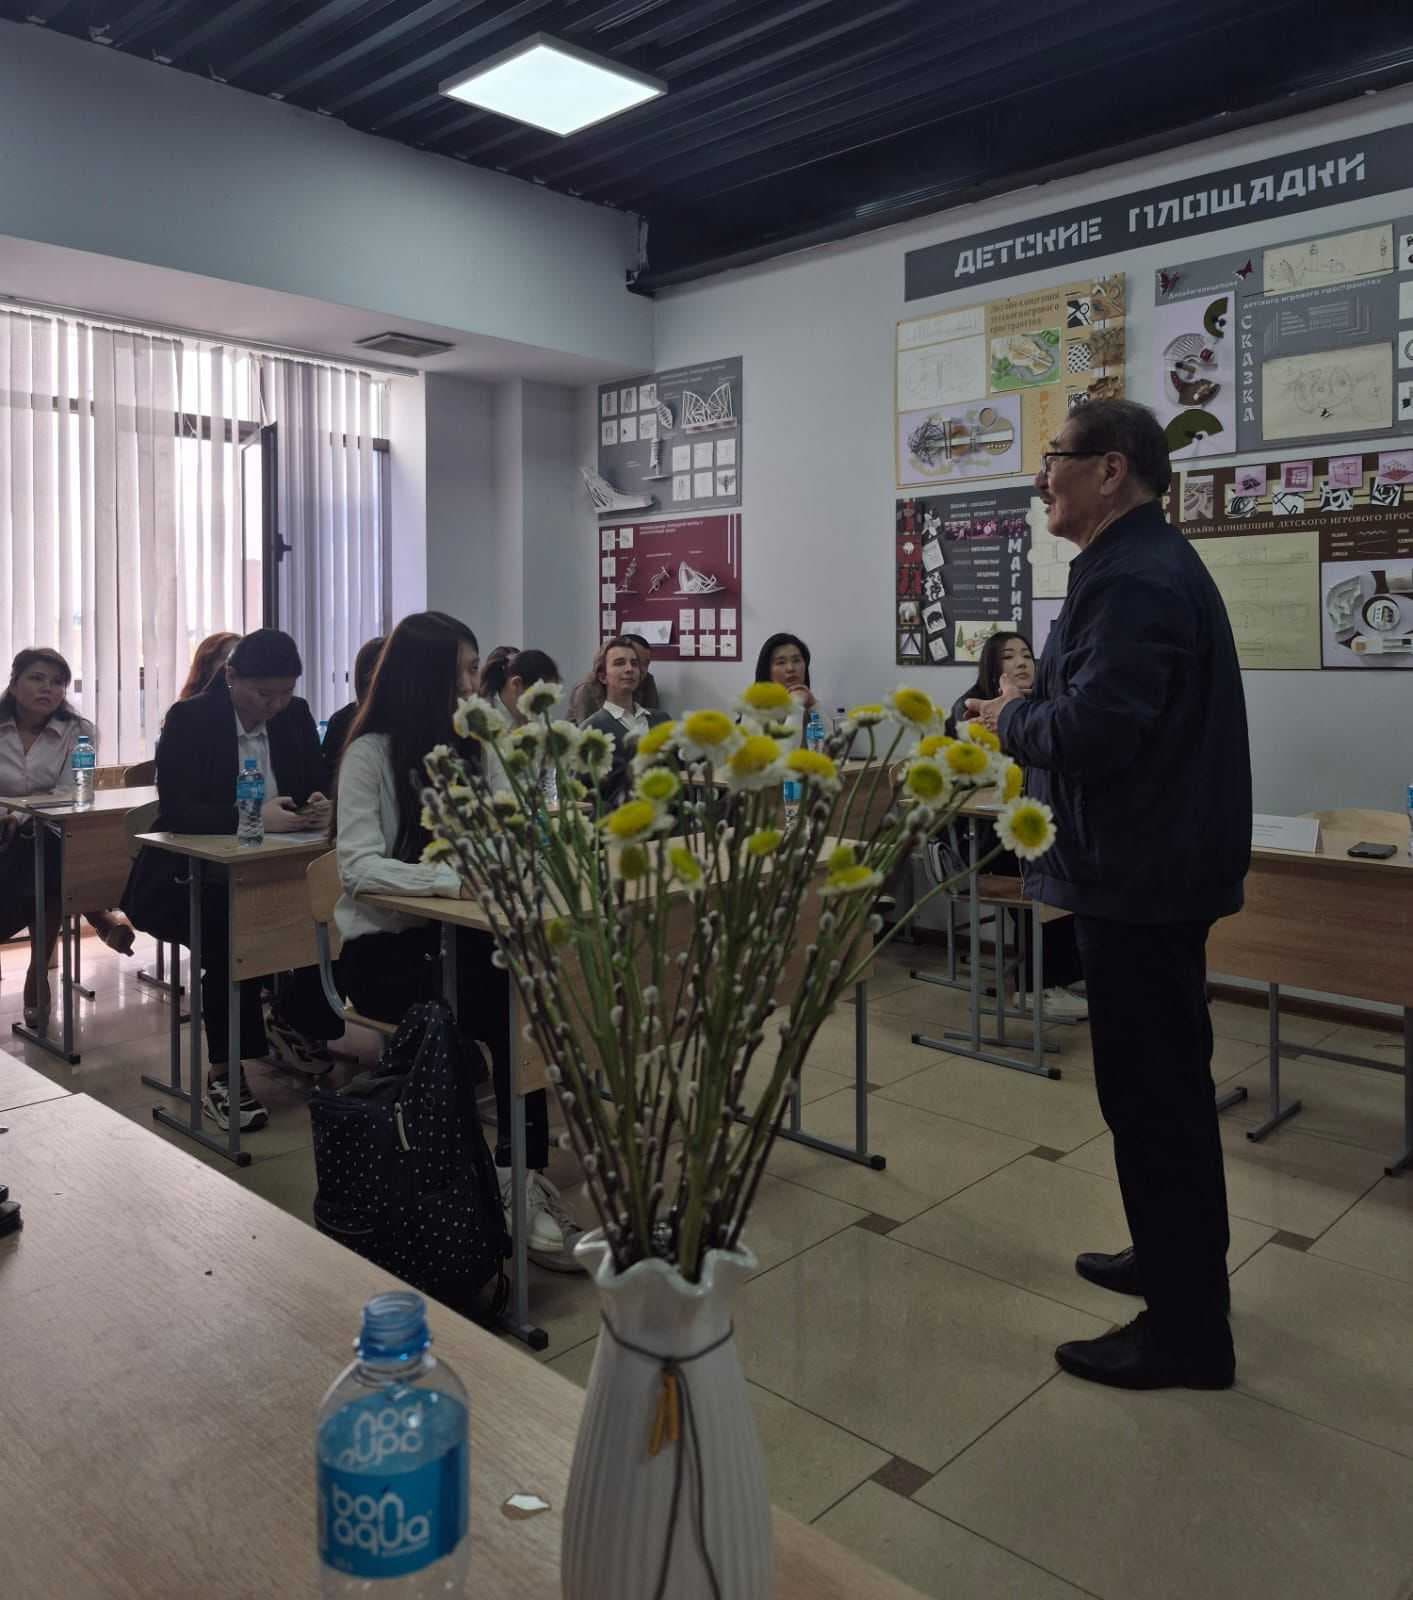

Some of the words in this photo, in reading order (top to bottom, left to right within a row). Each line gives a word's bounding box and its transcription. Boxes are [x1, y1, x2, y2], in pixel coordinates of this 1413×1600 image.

[954, 216, 1102, 278] ДЕТСКИЕ
[1128, 152, 1366, 233] ПЛОЩАДКИ
[1241, 315, 1255, 421] СКАЗКА
[1008, 538, 1022, 621] МАГИЯ
